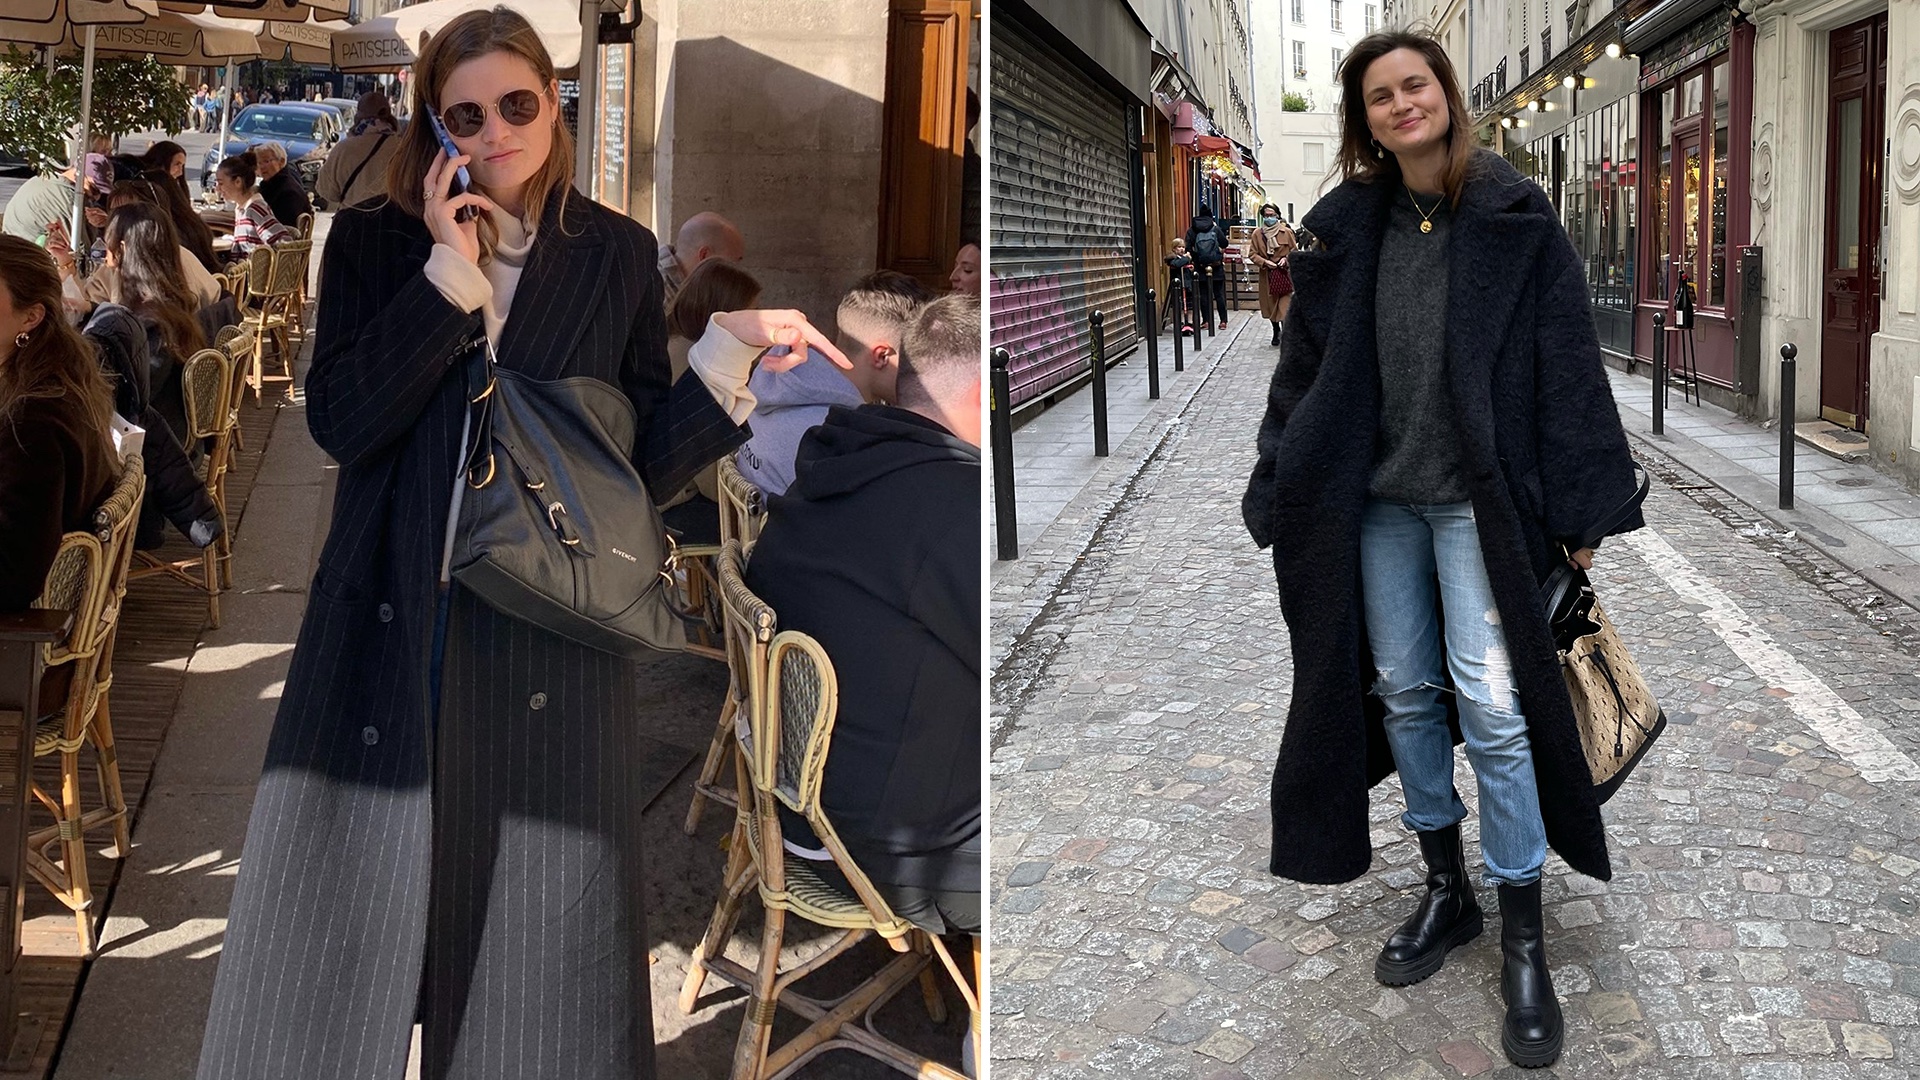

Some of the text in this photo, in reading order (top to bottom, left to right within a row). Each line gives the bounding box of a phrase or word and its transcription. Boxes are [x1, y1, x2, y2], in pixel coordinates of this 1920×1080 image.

[95, 26, 183, 48] ATISSERIE
[278, 23, 330, 43] PATISSER
[342, 38, 410, 59] PATISSERIE
